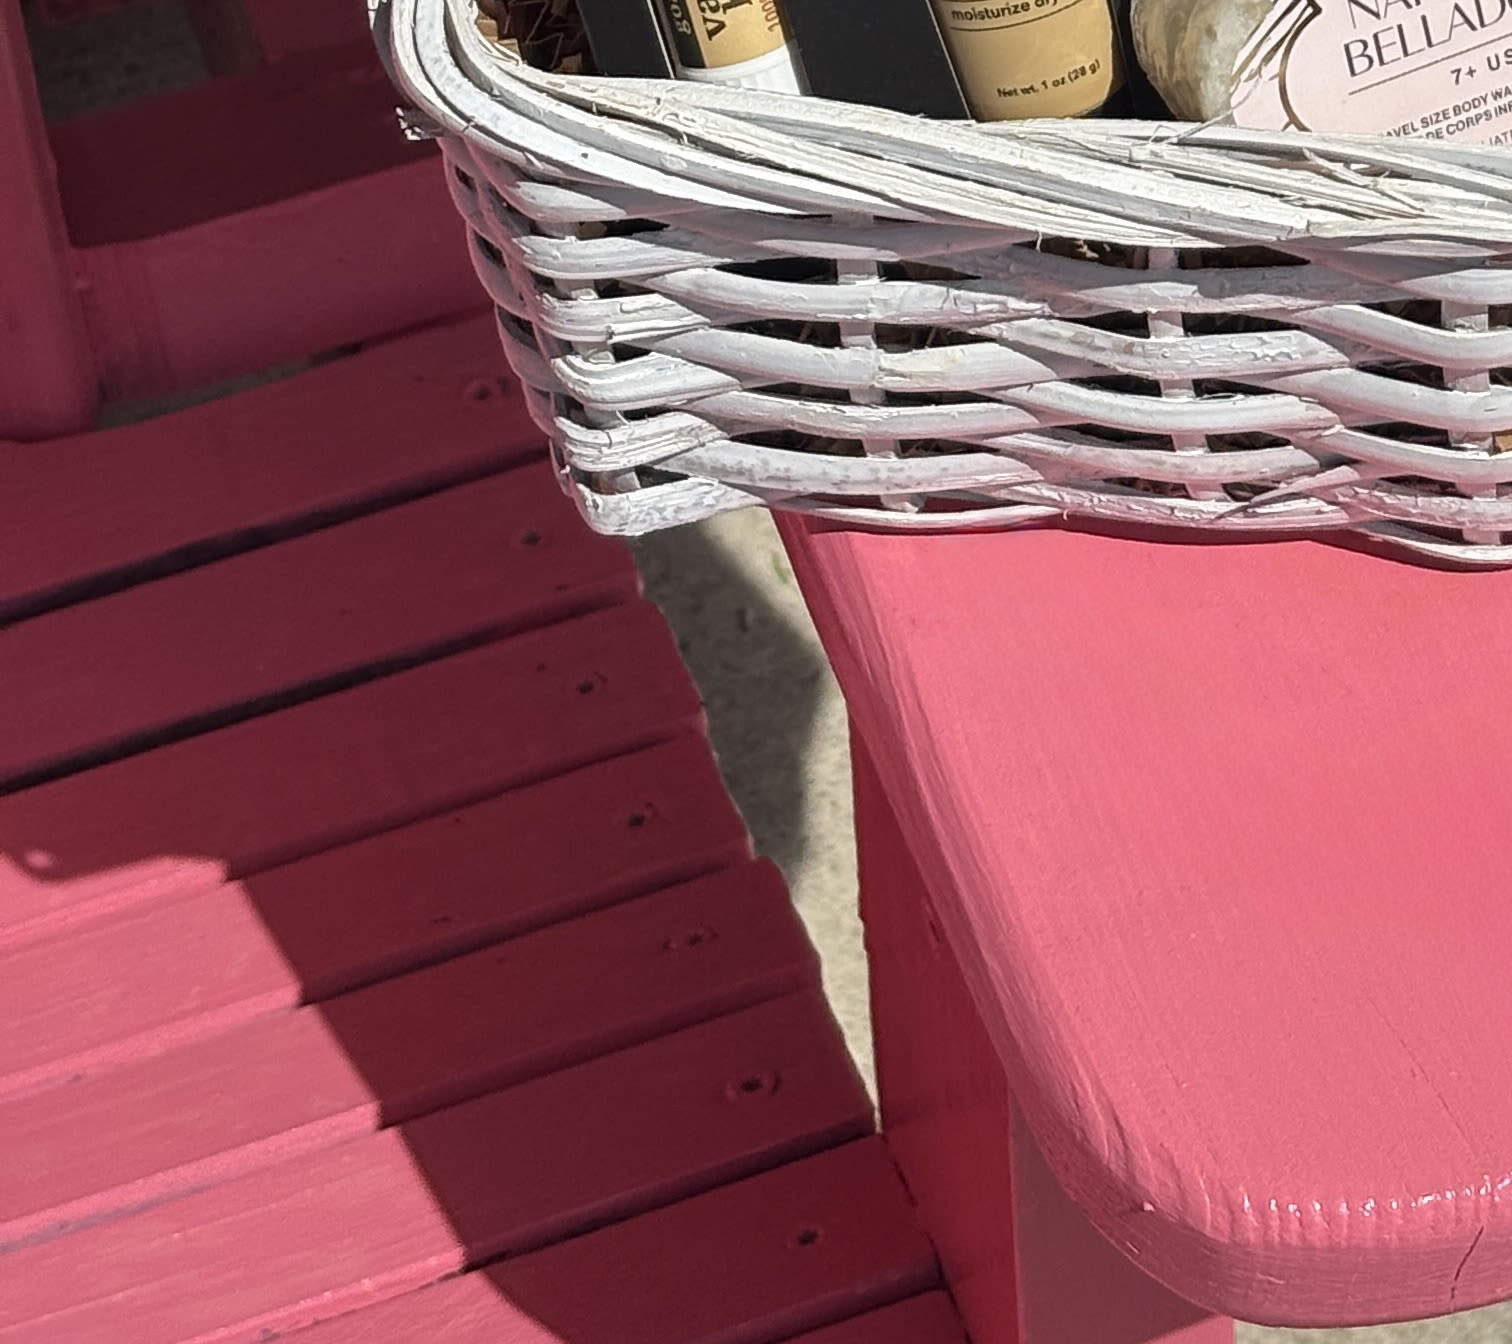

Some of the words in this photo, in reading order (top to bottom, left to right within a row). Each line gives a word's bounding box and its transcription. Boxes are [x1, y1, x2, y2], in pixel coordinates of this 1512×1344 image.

[952, 1, 1031, 23] moisturize
[1450, 65, 1477, 86] 7+
[1384, 121, 1420, 137] AVEL
[1420, 107, 1452, 129] SIZE
[1452, 92, 1489, 117] BODY
[1446, 108, 1493, 136] CORPS
